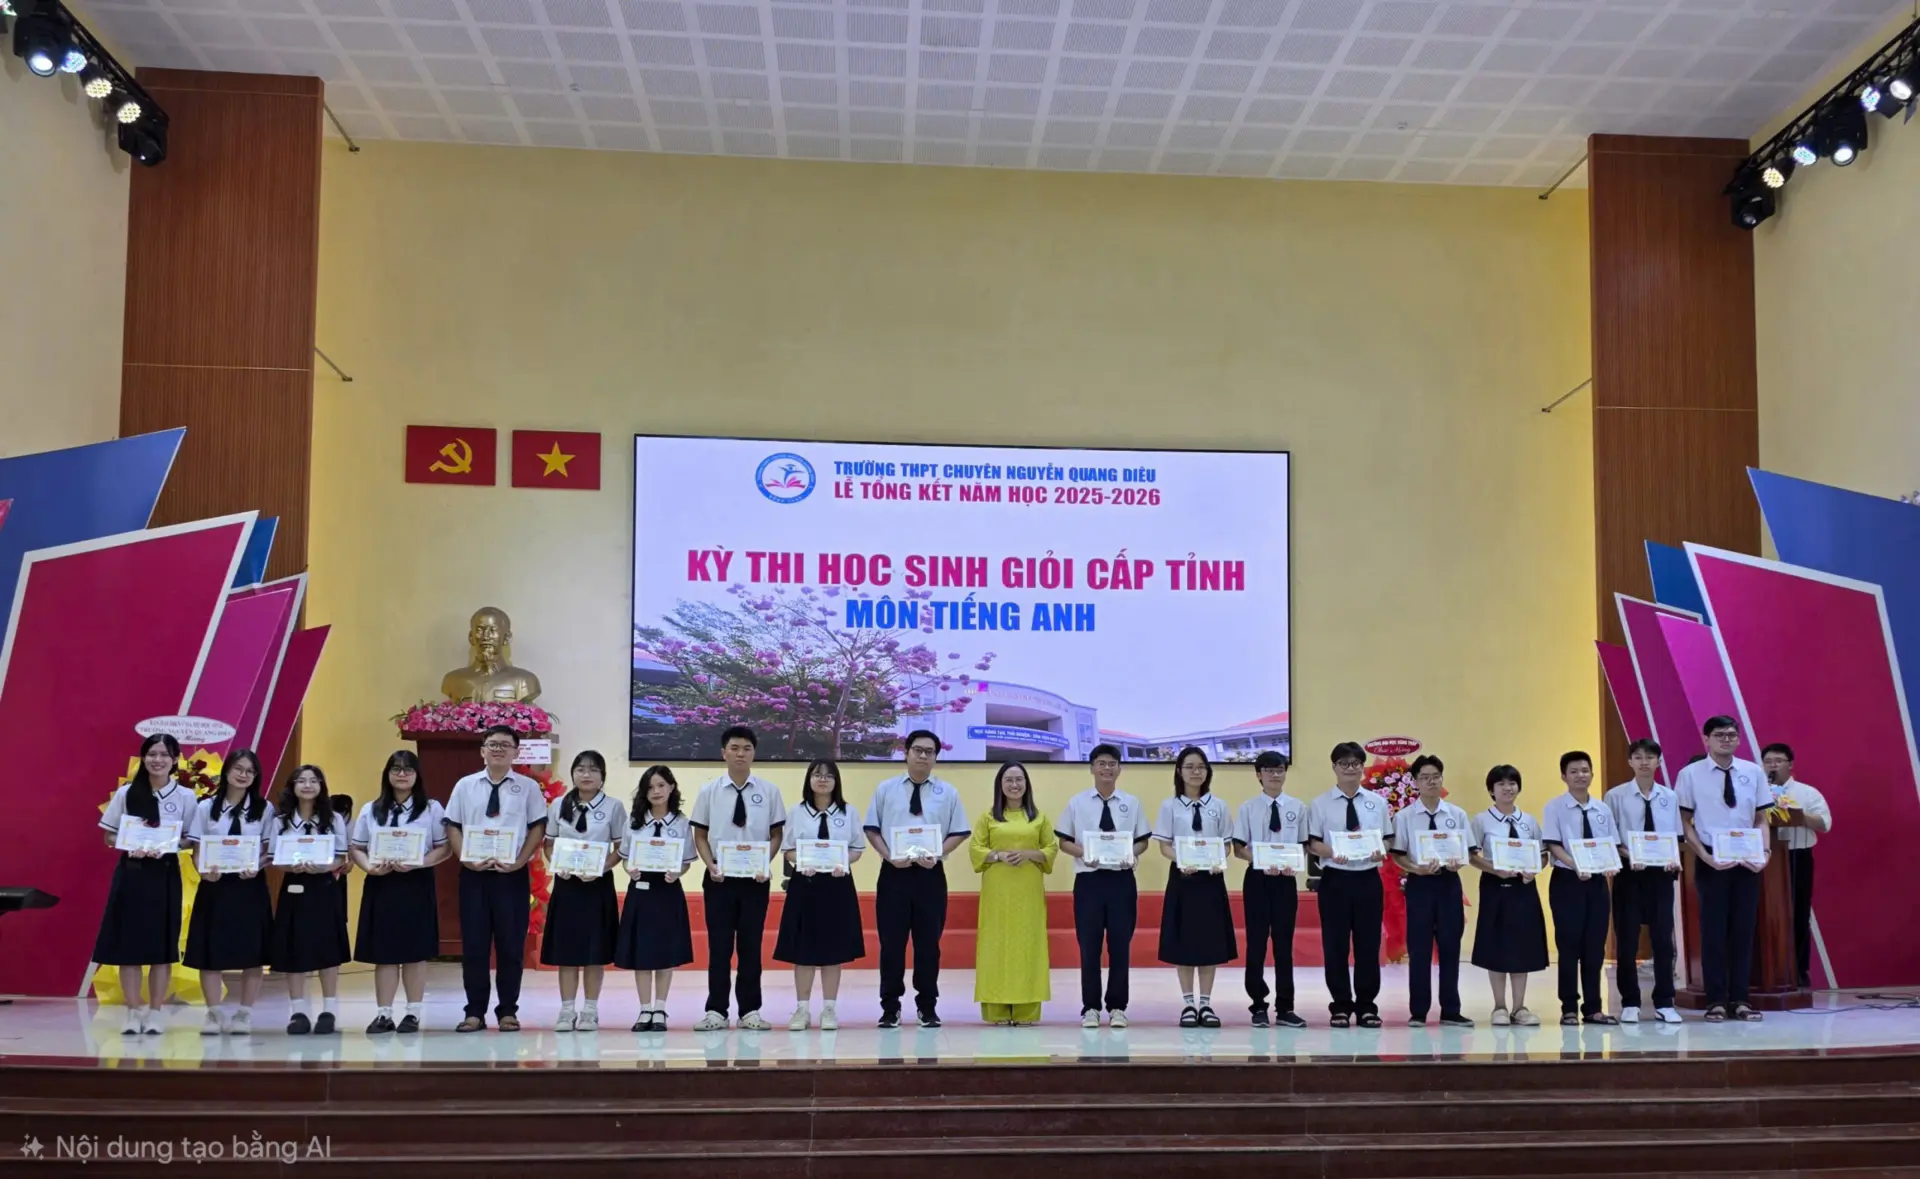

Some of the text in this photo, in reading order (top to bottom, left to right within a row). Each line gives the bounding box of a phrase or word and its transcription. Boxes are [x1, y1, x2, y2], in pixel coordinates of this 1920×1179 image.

[834, 459, 896, 476] TRƯỜNG
[900, 463, 939, 478] THPT
[943, 463, 1002, 479] CHUYÊN
[1006, 462, 1064, 481] NGUYỄN
[1068, 467, 1118, 483] QUANG
[834, 476, 854, 499] LỄ
[860, 476, 912, 500] TỔNG
[918, 478, 953, 501] KẾT
[959, 481, 1002, 502] NĂM
[1008, 485, 1048, 507] HỌC
[1054, 486, 1161, 506] 2025-2026
[687, 545, 1245, 592] KỲ THI HỌC SINH GIỎI CẤP TỈNH
[846, 592, 1096, 632] MÔN TIẾNG ANH
